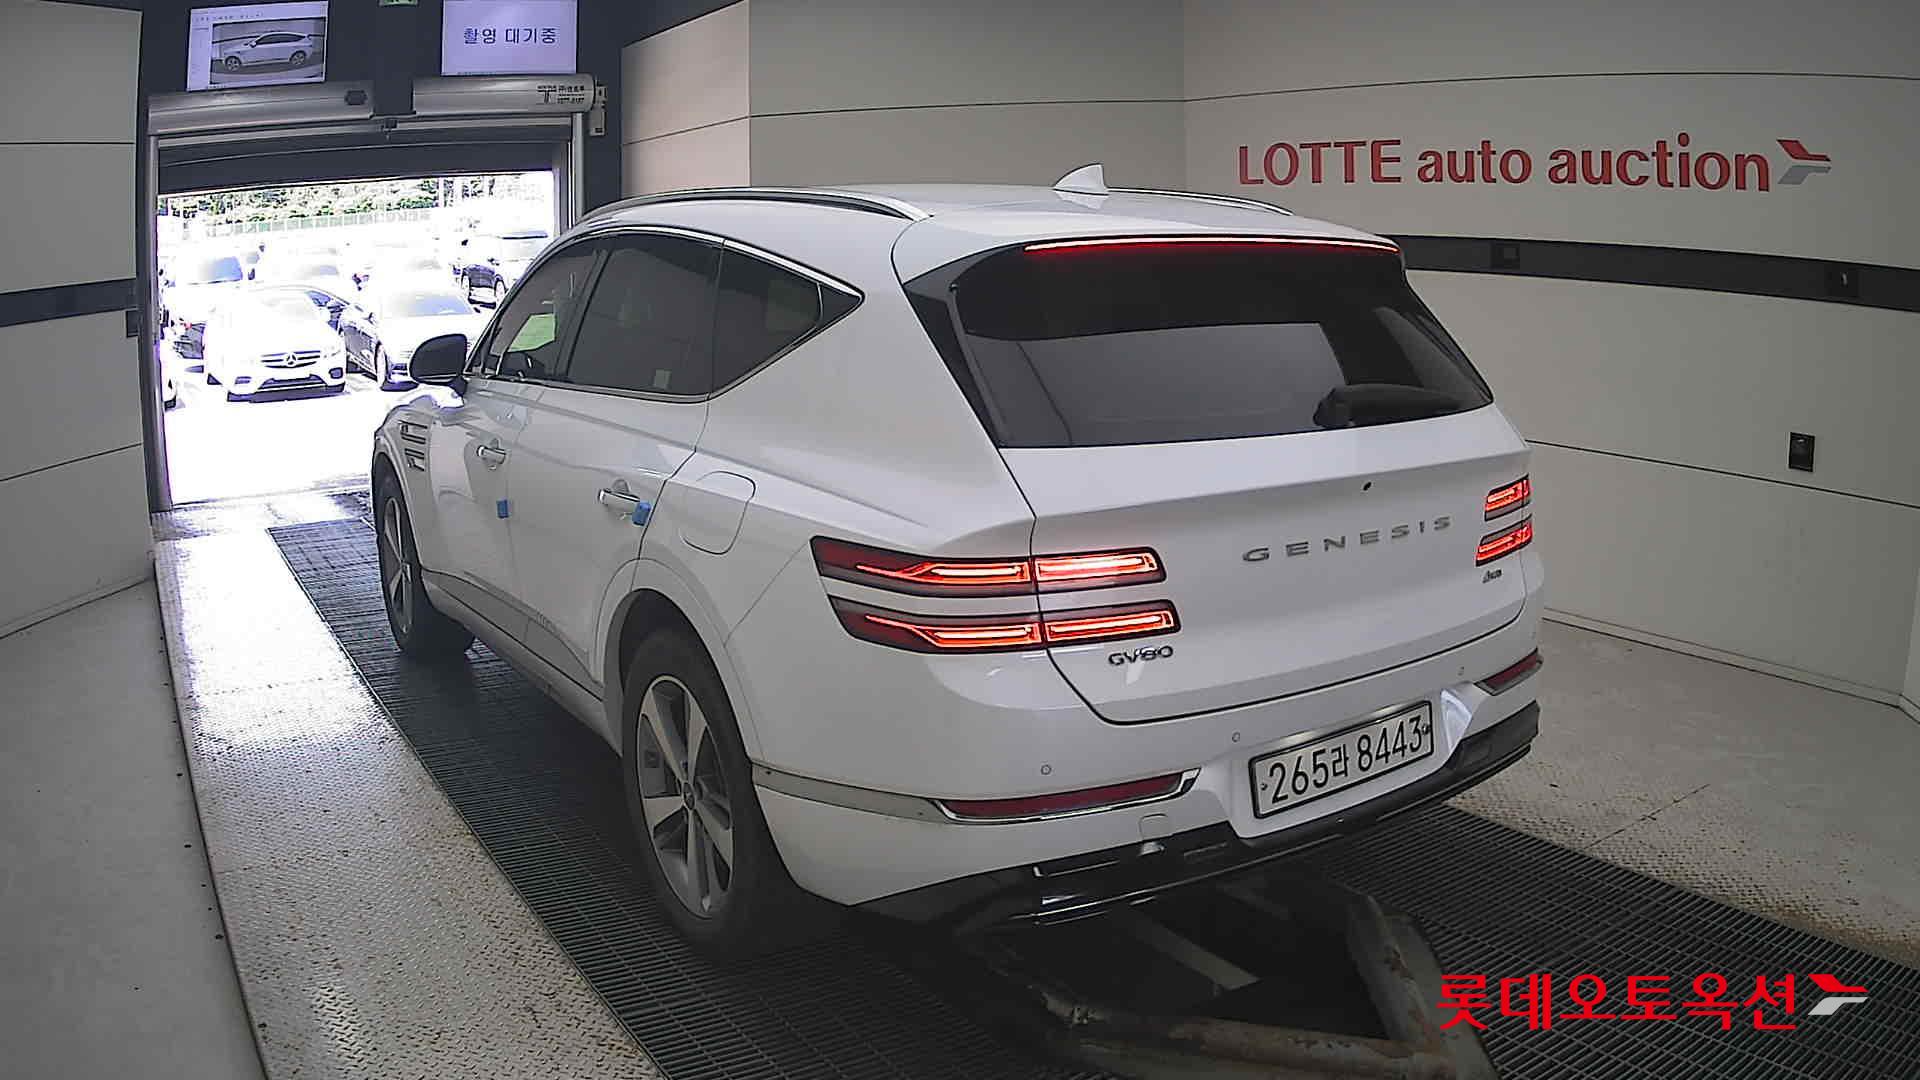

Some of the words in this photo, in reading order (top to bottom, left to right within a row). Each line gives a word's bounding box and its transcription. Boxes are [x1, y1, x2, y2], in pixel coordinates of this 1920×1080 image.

[464, 27, 497, 45] 촬영
[505, 27, 557, 45] 대기중
[1238, 138, 1402, 186] LOTTE
[1417, 140, 1533, 185] auto
[1547, 131, 1771, 192] auction
[1242, 515, 1452, 563] GENESIS
[1108, 645, 1174, 666] GV80
[1269, 743, 1349, 804] 265라
[1357, 714, 1423, 772] 8443
